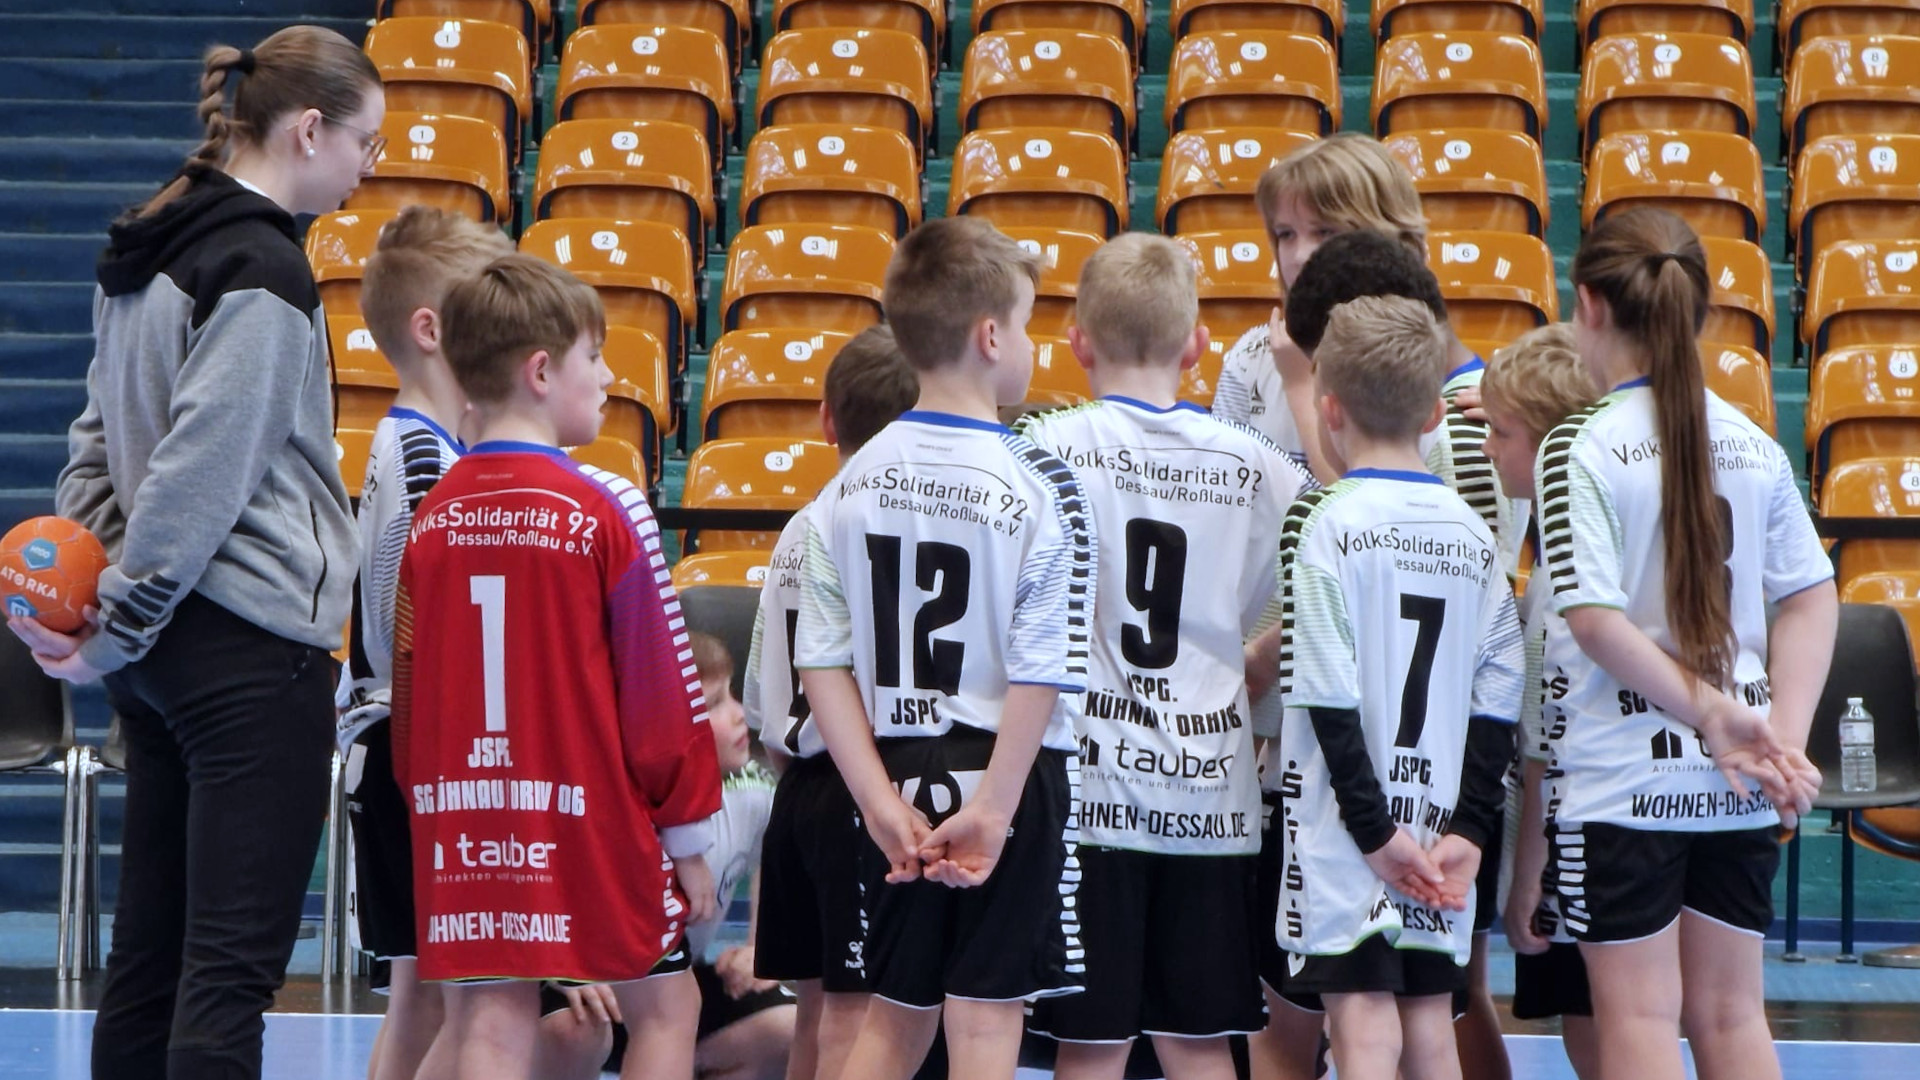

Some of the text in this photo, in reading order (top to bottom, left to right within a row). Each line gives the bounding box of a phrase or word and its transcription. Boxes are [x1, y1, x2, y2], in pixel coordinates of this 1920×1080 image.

[1057, 444, 1263, 493] VolksSolidarität 92
[840, 468, 1028, 522] VolksSolidarität 92
[1115, 475, 1232, 505] Dessau/Roßlau
[568, 511, 598, 539] 92
[879, 493, 1019, 540] Dessau/Roßlau e.V.
[447, 529, 593, 556] Dessau/Roßlau e.V.
[1480, 549, 1495, 571] 9
[0, 565, 58, 600] ATORKA
[1121, 518, 1188, 669] 9
[864, 533, 971, 697] 12
[469, 575, 507, 732] 1
[1394, 593, 1446, 749] 7
[1115, 738, 1235, 779] tauber
[1389, 755, 1434, 788] JSPG.
[1082, 771, 1143, 785] chitekten
[557, 783, 586, 817] 06
[1079, 801, 1249, 839] HNEN-DESSAU.DE
[456, 832, 557, 869] tauber
